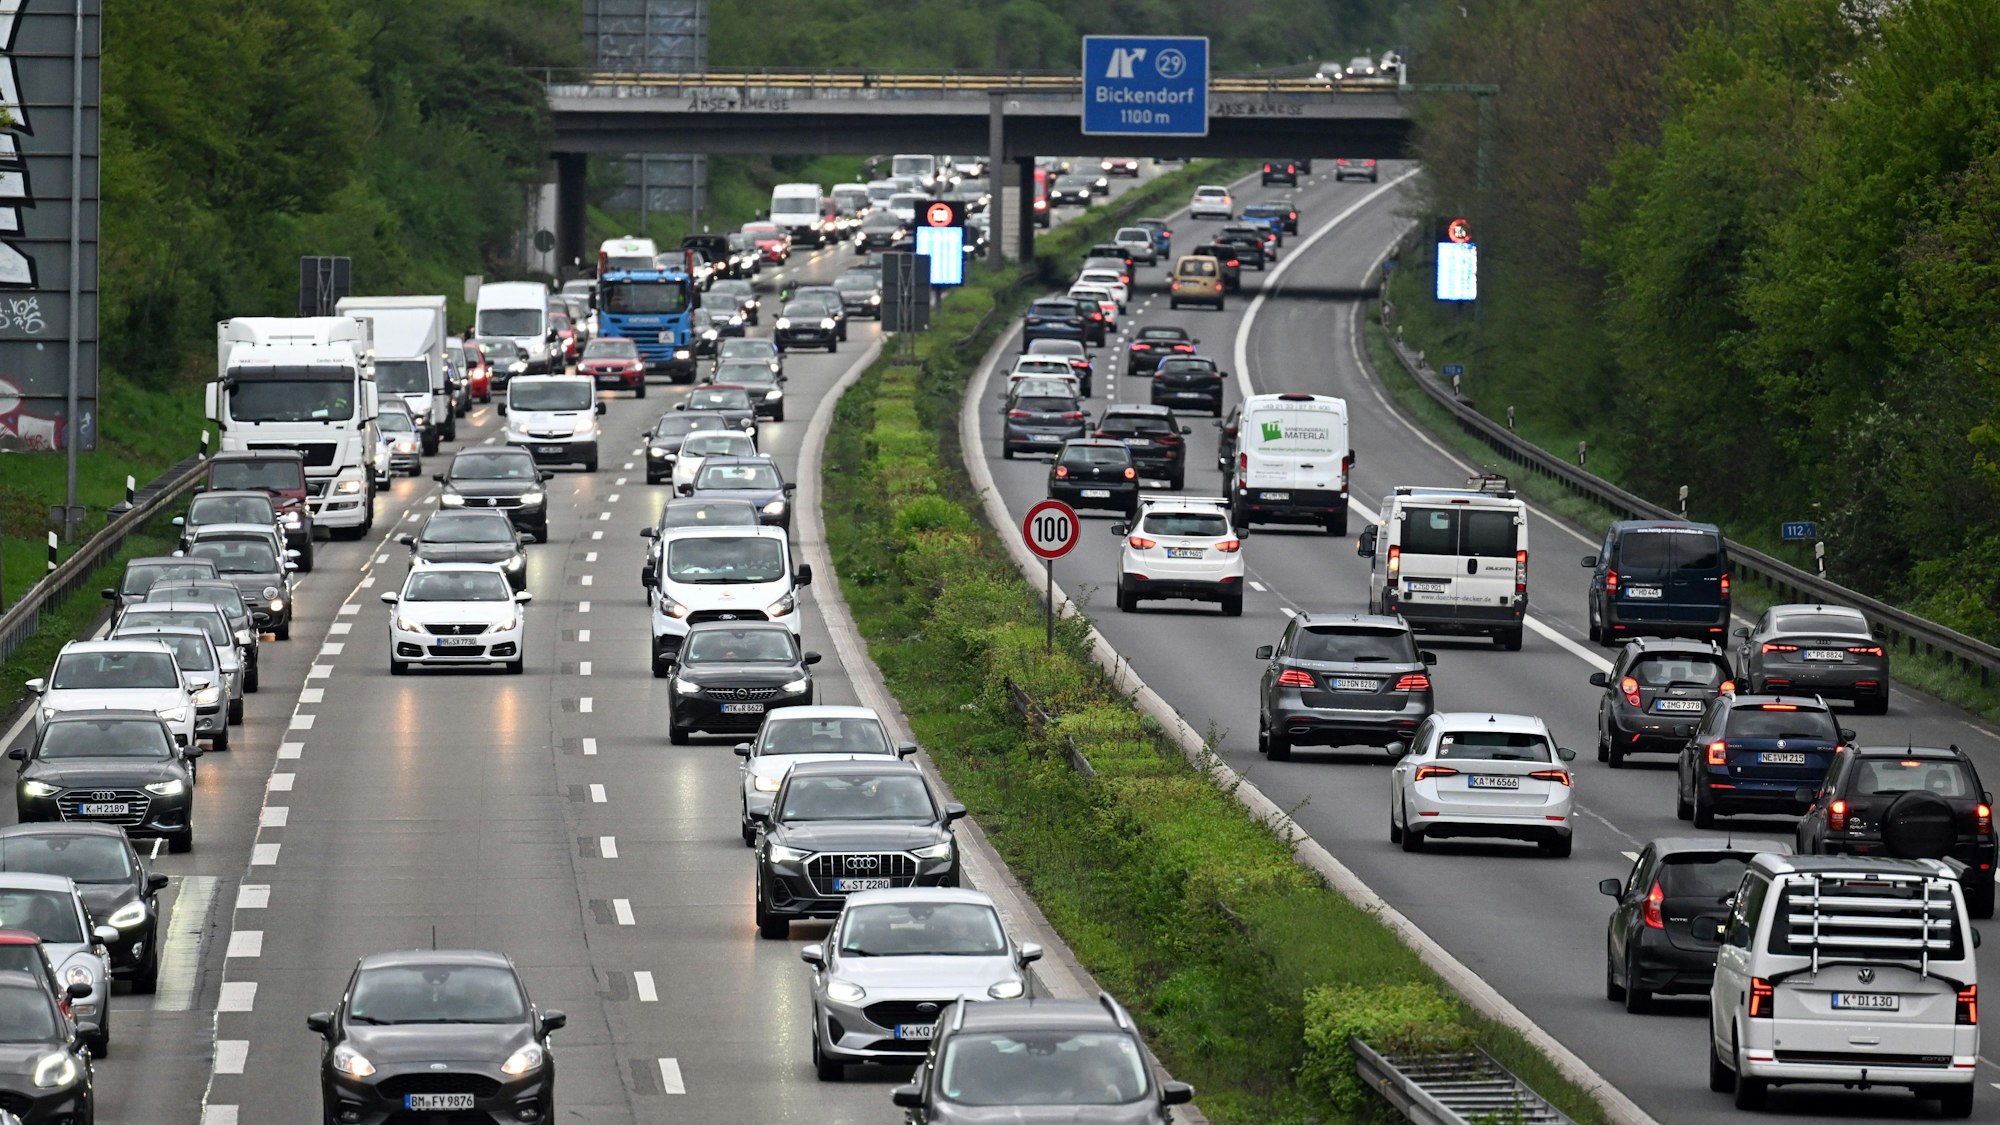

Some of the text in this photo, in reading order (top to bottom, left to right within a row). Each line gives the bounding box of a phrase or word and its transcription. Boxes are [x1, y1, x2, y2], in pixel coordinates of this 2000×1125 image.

[1160, 55, 1181, 72] 29
[1096, 86, 1194, 103] Bickendorf
[1120, 109, 1170, 124] 1100 m
[1284, 431, 1325, 440] MATERLA
[1035, 516, 1068, 542] 100
[1360, 681, 1377, 689] 8286
[1762, 753, 1773, 761] NE
[1790, 754, 1804, 762] 215
[1473, 777, 1484, 786] KA
[1496, 778, 1518, 787] 6566
[104, 804, 125, 813] 2189
[852, 880, 864, 889] ST
[866, 880, 889, 889] 2280
[1843, 994, 1893, 1007] K DI 130
[902, 1026, 908, 1037] K
[916, 1026, 930, 1037] KQ
[411, 1095, 473, 1107] BM FY 9876
